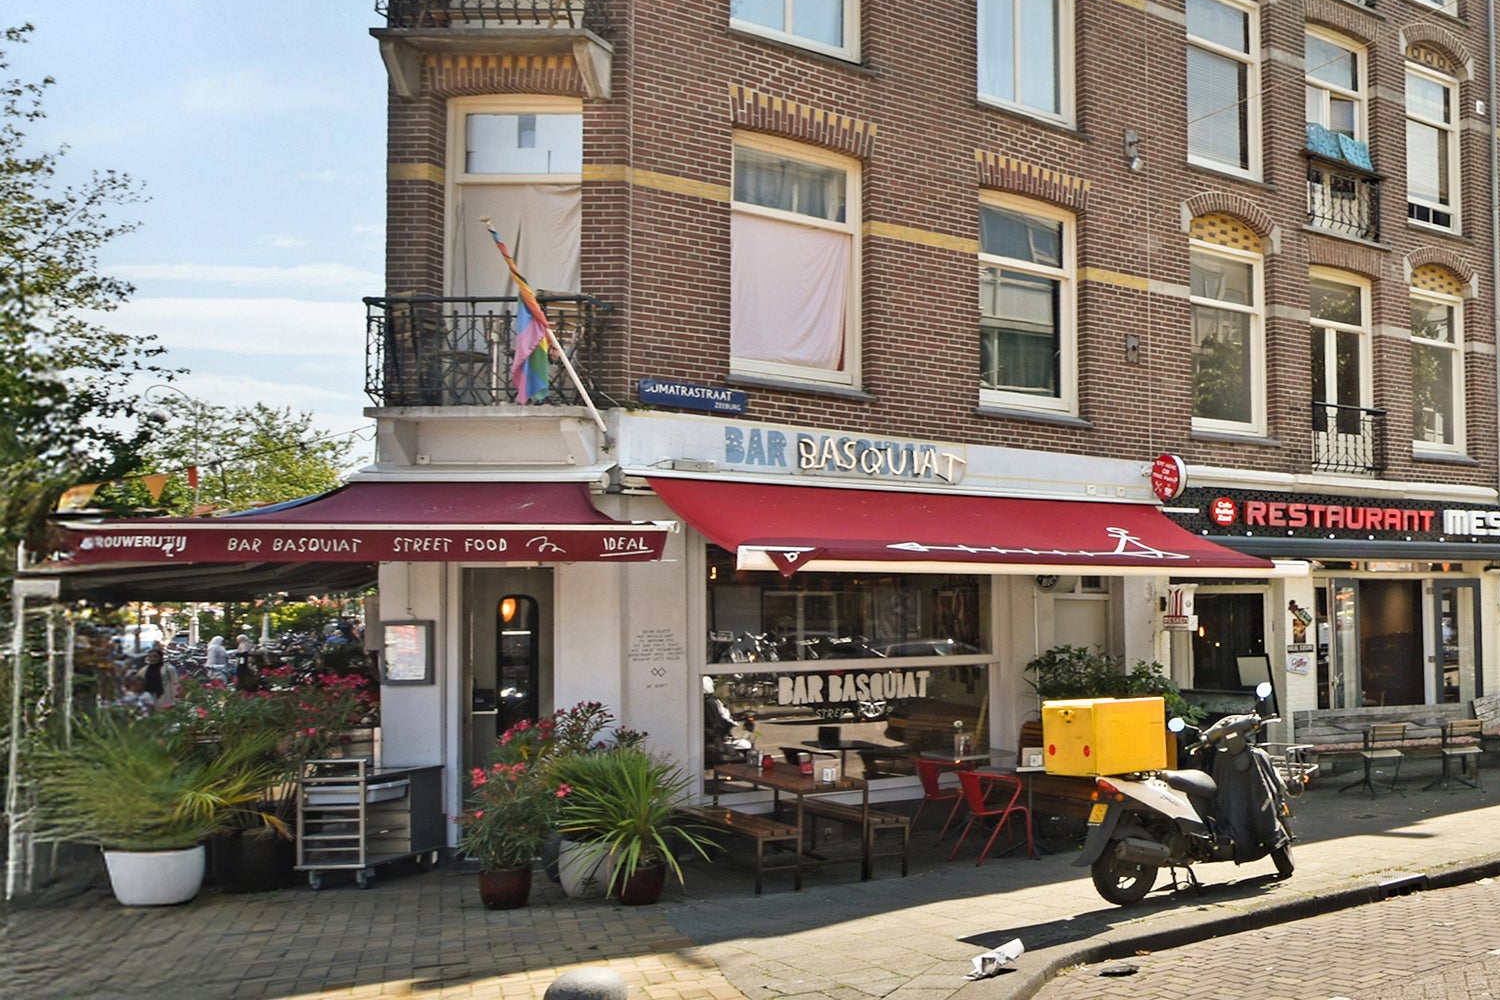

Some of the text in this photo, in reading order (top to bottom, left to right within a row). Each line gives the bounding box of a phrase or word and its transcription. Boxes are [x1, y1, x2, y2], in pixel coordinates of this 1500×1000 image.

[714, 402, 742, 411] ZEEBURG
[725, 426, 787, 468] BAR
[800, 438, 967, 482] BASQUIAT
[1246, 501, 1435, 532] RESTAURANT
[227, 537, 648, 553] BAR BASQUIAT STREET FOOD IDEAL
[778, 670, 931, 705] BAR BASQUIAT
